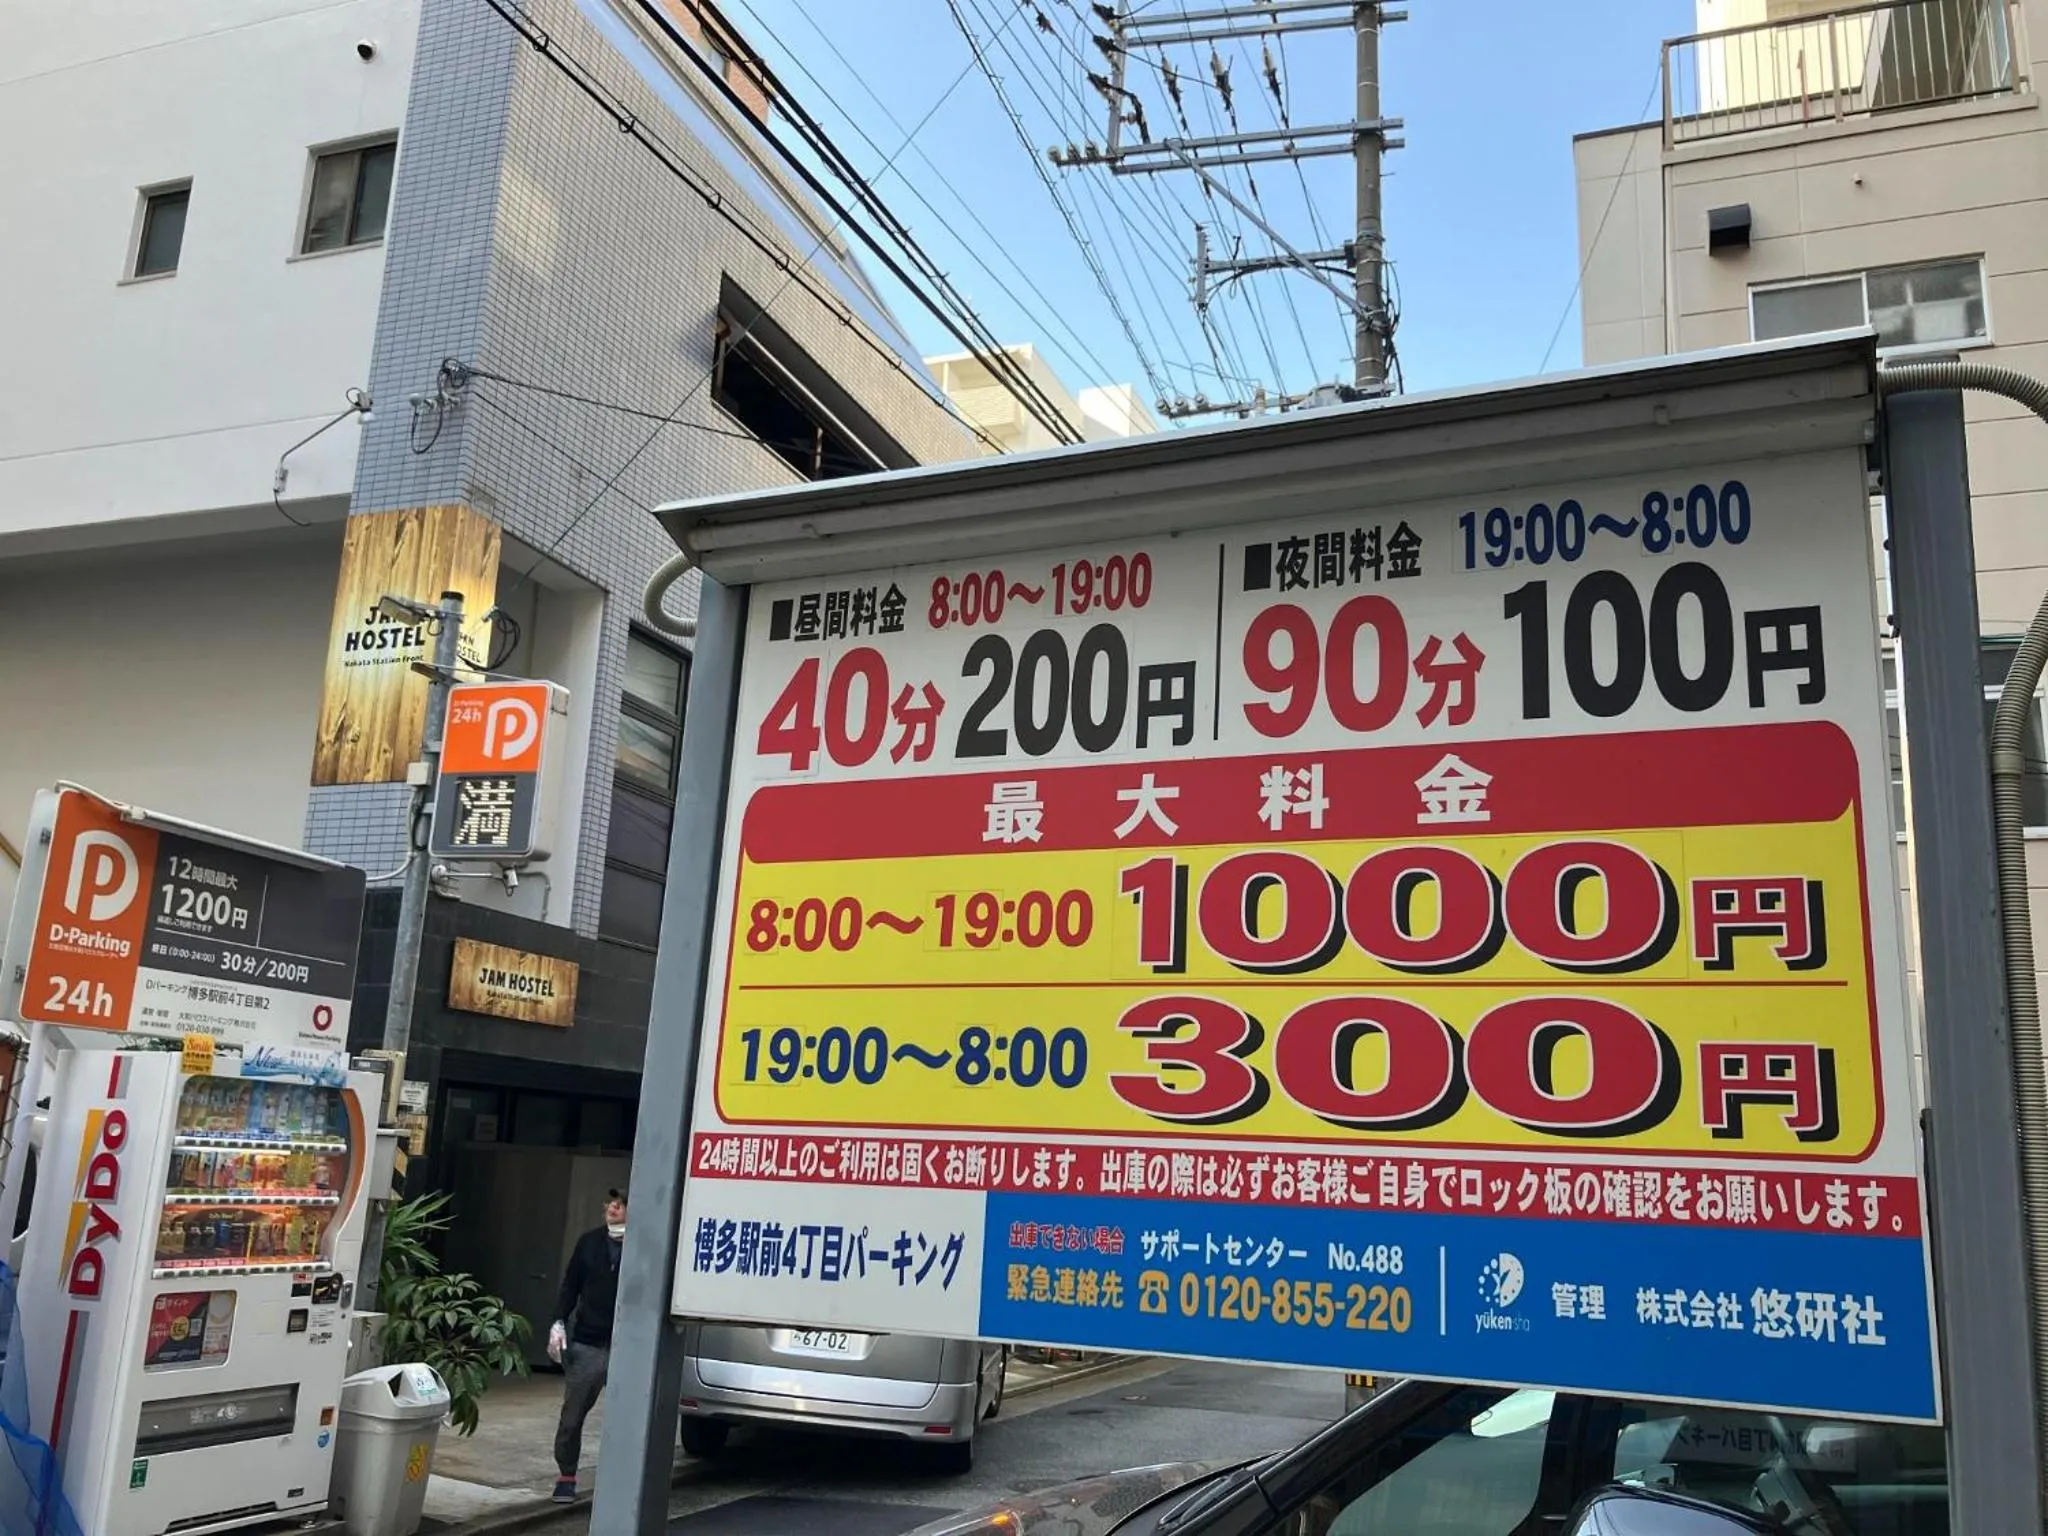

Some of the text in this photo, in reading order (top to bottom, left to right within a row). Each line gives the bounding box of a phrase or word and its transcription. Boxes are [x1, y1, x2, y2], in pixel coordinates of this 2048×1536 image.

[1275, 521, 1424, 593] 夜間料金
[345, 626, 426, 652] HOSTEL
[794, 583, 908, 642] 昼間料金
[1242, 562, 1826, 738] 90分 100円
[452, 709, 482, 724] 24h
[757, 623, 1197, 772] 40分 200円
[454, 781, 515, 845] 満
[168, 856, 239, 891] 12時間最大
[161, 884, 249, 930] 1200円
[1118, 842, 1826, 975] 1000円
[50, 923, 130, 957] D-Parking
[43, 977, 114, 1018] 24h
[479, 967, 506, 988] JAM
[508, 972, 555, 998] HOSTEL
[1108, 996, 1840, 1142] 300円
[693, 1215, 966, 1292] 博多駅前4丁目パーキング
[1008, 1221, 1404, 1275] 出庫できない場合 サポートセンター No.488
[1006, 1263, 1412, 1333] 緊急連絡先 0120-855-220
[1551, 1281, 1607, 1320] 管理
